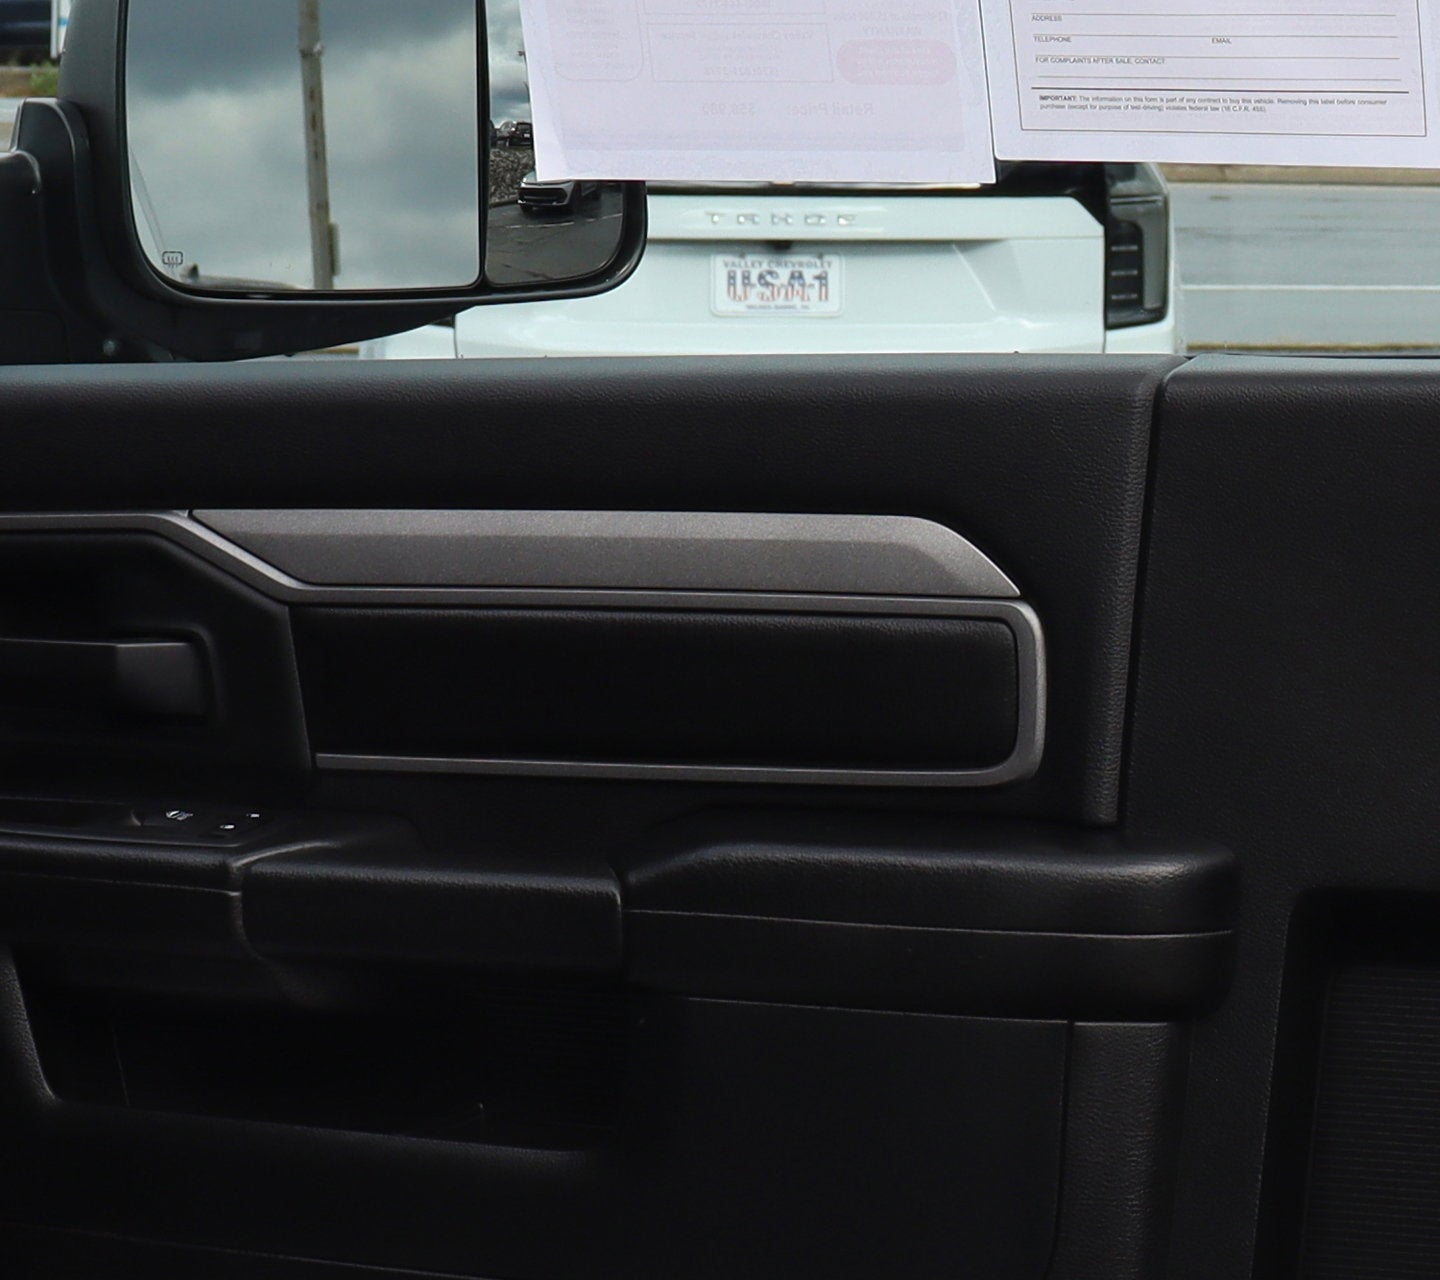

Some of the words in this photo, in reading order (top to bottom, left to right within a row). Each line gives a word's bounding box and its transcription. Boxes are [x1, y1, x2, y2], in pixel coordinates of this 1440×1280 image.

[705, 212, 857, 226] TAHOE
[723, 259, 764, 269] VALLEY
[767, 259, 833, 270] CHEVROLET
